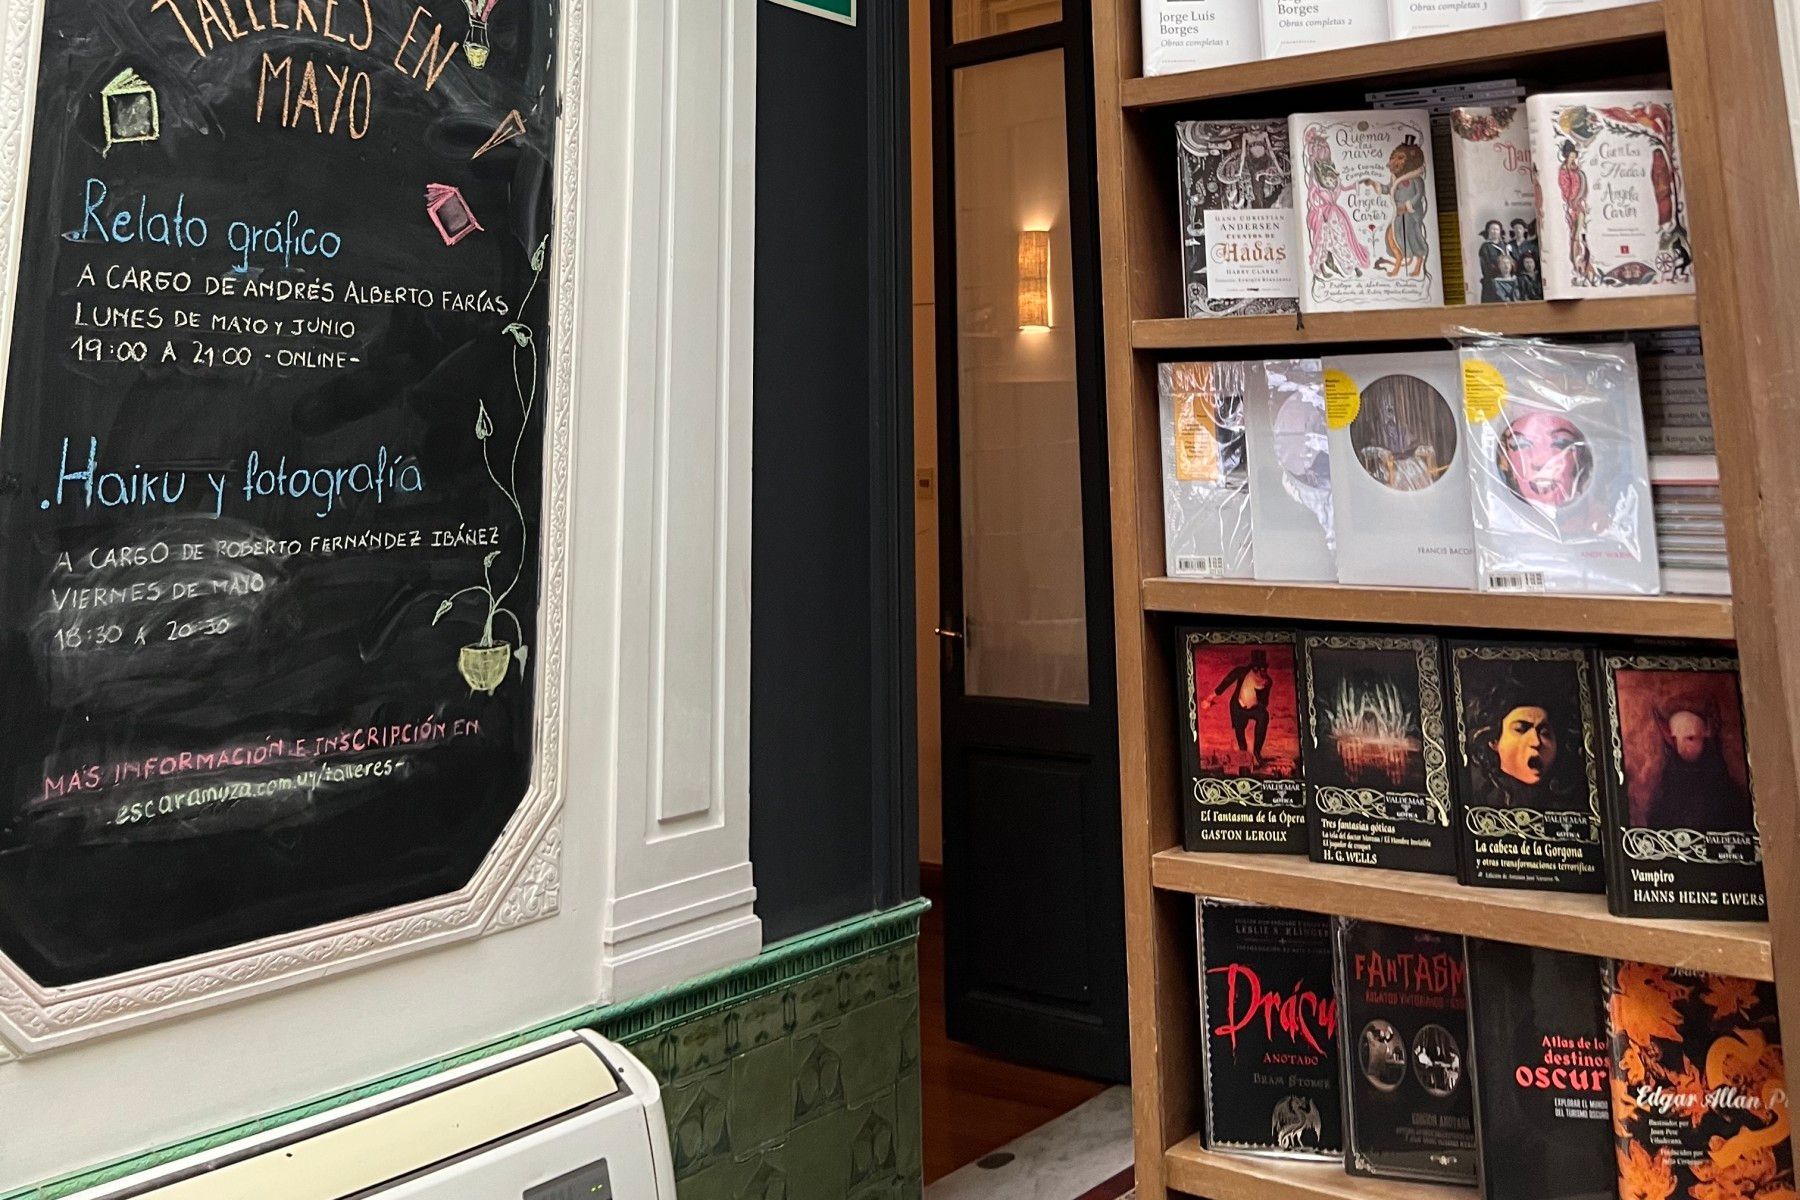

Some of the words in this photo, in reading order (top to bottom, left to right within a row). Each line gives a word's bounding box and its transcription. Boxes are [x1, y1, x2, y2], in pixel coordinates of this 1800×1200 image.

[1278, 4, 1319, 17] Borges
[393, 5, 459, 92] EN
[256, 52, 371, 140] MAYO
[1352, 209, 1387, 222] Carter
[82, 178, 208, 247] Relato
[228, 209, 341, 274] gráfico
[1220, 222, 1280, 232] ANDERSEN
[76, 263, 96, 288] A
[106, 264, 191, 293] CARGO
[205, 276, 237, 296] DE
[243, 277, 334, 303] ANDRÉS
[344, 280, 434, 308] ALBERTO
[442, 289, 509, 316] FARÍAS
[75, 301, 164, 329] LUNES
[174, 309, 201, 328] DE
[211, 314, 268, 335] MAYO
[290, 317, 355, 339] JUNIO
[70, 335, 147, 362] 19:00
[160, 340, 177, 363] A
[56, 436, 185, 508] Haiku
[208, 473, 225, 519] y
[242, 445, 423, 518] fotografía
[52, 551, 73, 573] A
[89, 541, 169, 569] CARGO
[181, 543, 204, 561] DE
[216, 538, 302, 558] ROBERTO
[310, 530, 422, 552] FERNÁNDEZ
[51, 582, 160, 611] VIERNES
[172, 582, 199, 601] DE
[212, 573, 265, 596] MAYO
[134, 626, 146, 645] A
[43, 764, 101, 800] MÁS
[113, 735, 283, 786] INFORMACIÓN
[290, 739, 307, 757] E
[313, 714, 446, 757] INSCRIPCIÓN
[453, 719, 479, 736] EN
[1200, 809, 1211, 822] El
[1256, 810, 1265, 823] de
[1268, 811, 1277, 823] la
[1321, 818, 1336, 830] Tres
[1201, 829, 1242, 841] GASTON
[1245, 830, 1287, 842] LEROUX
[1346, 851, 1377, 864] WELLS
[1475, 839, 1487, 853] La
[1489, 840, 1518, 855] cabeza
[1520, 841, 1531, 855] de
[1533, 841, 1543, 856] la
[1544, 844, 1583, 862] Gorgona
[1482, 858, 1499, 867] otras
[1630, 868, 1675, 887] Vampiro
[1633, 889, 1675, 903] HANNS
[1679, 891, 1718, 904] HEINZ
[1722, 892, 1765, 906] EWERS
[1542, 1035, 1574, 1049] Atlas
[1577, 1036, 1591, 1050] de
[1263, 1052, 1318, 1066] ANOTADO
[1636, 1085, 1698, 1114] Edgar
[1701, 1085, 1762, 1110] Allan
